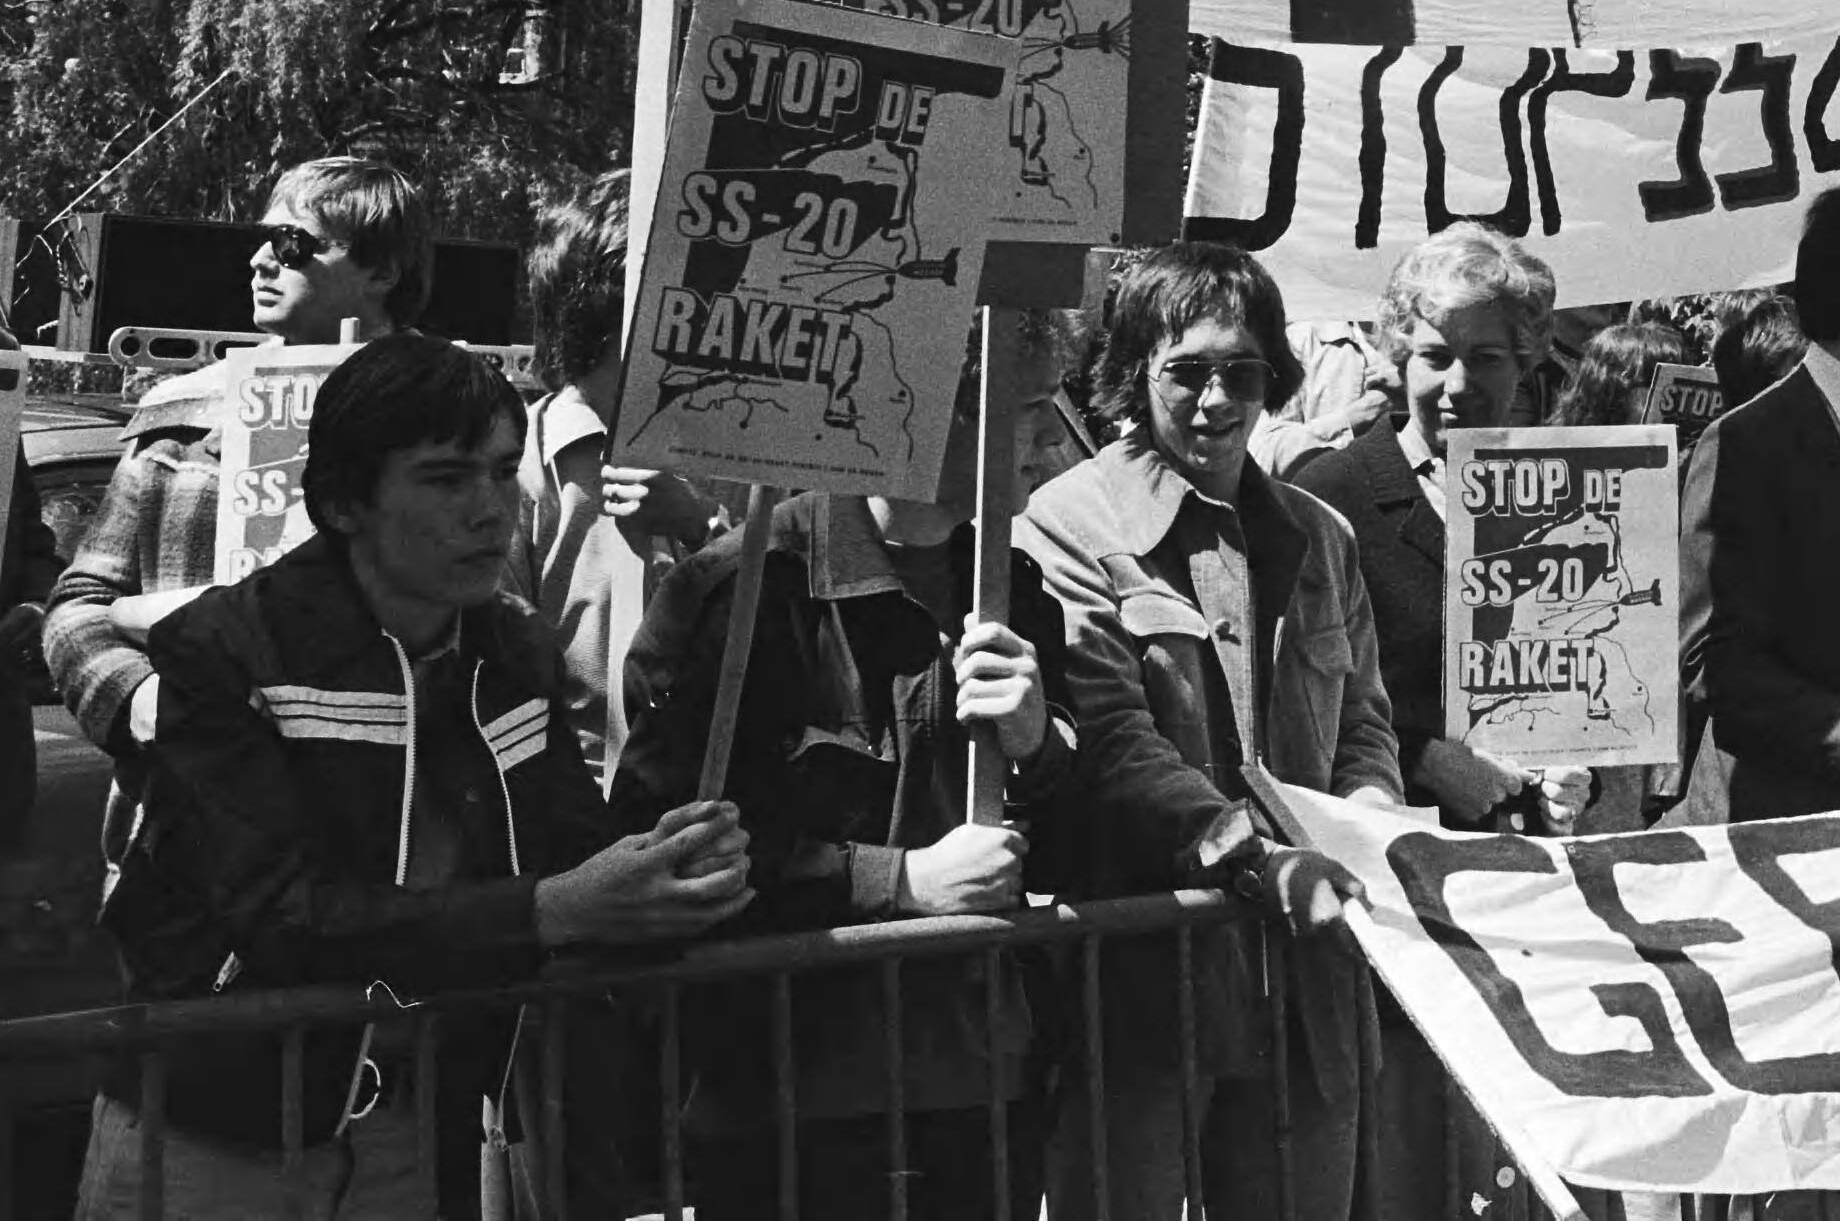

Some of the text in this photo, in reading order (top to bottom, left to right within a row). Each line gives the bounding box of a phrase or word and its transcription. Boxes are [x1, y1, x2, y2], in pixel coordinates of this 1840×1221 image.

[701, 35, 862, 133] STOP
[874, 81, 935, 146] DE
[676, 169, 858, 259] SS-20
[652, 286, 857, 381] RAKET
[239, 374, 326, 431] STO
[1660, 385, 1724, 418] STOP
[233, 469, 305, 516] SS-
[1460, 458, 1623, 517] STOP DE
[1460, 558, 1585, 607] SS-20
[1459, 636, 1595, 695] RAKET
